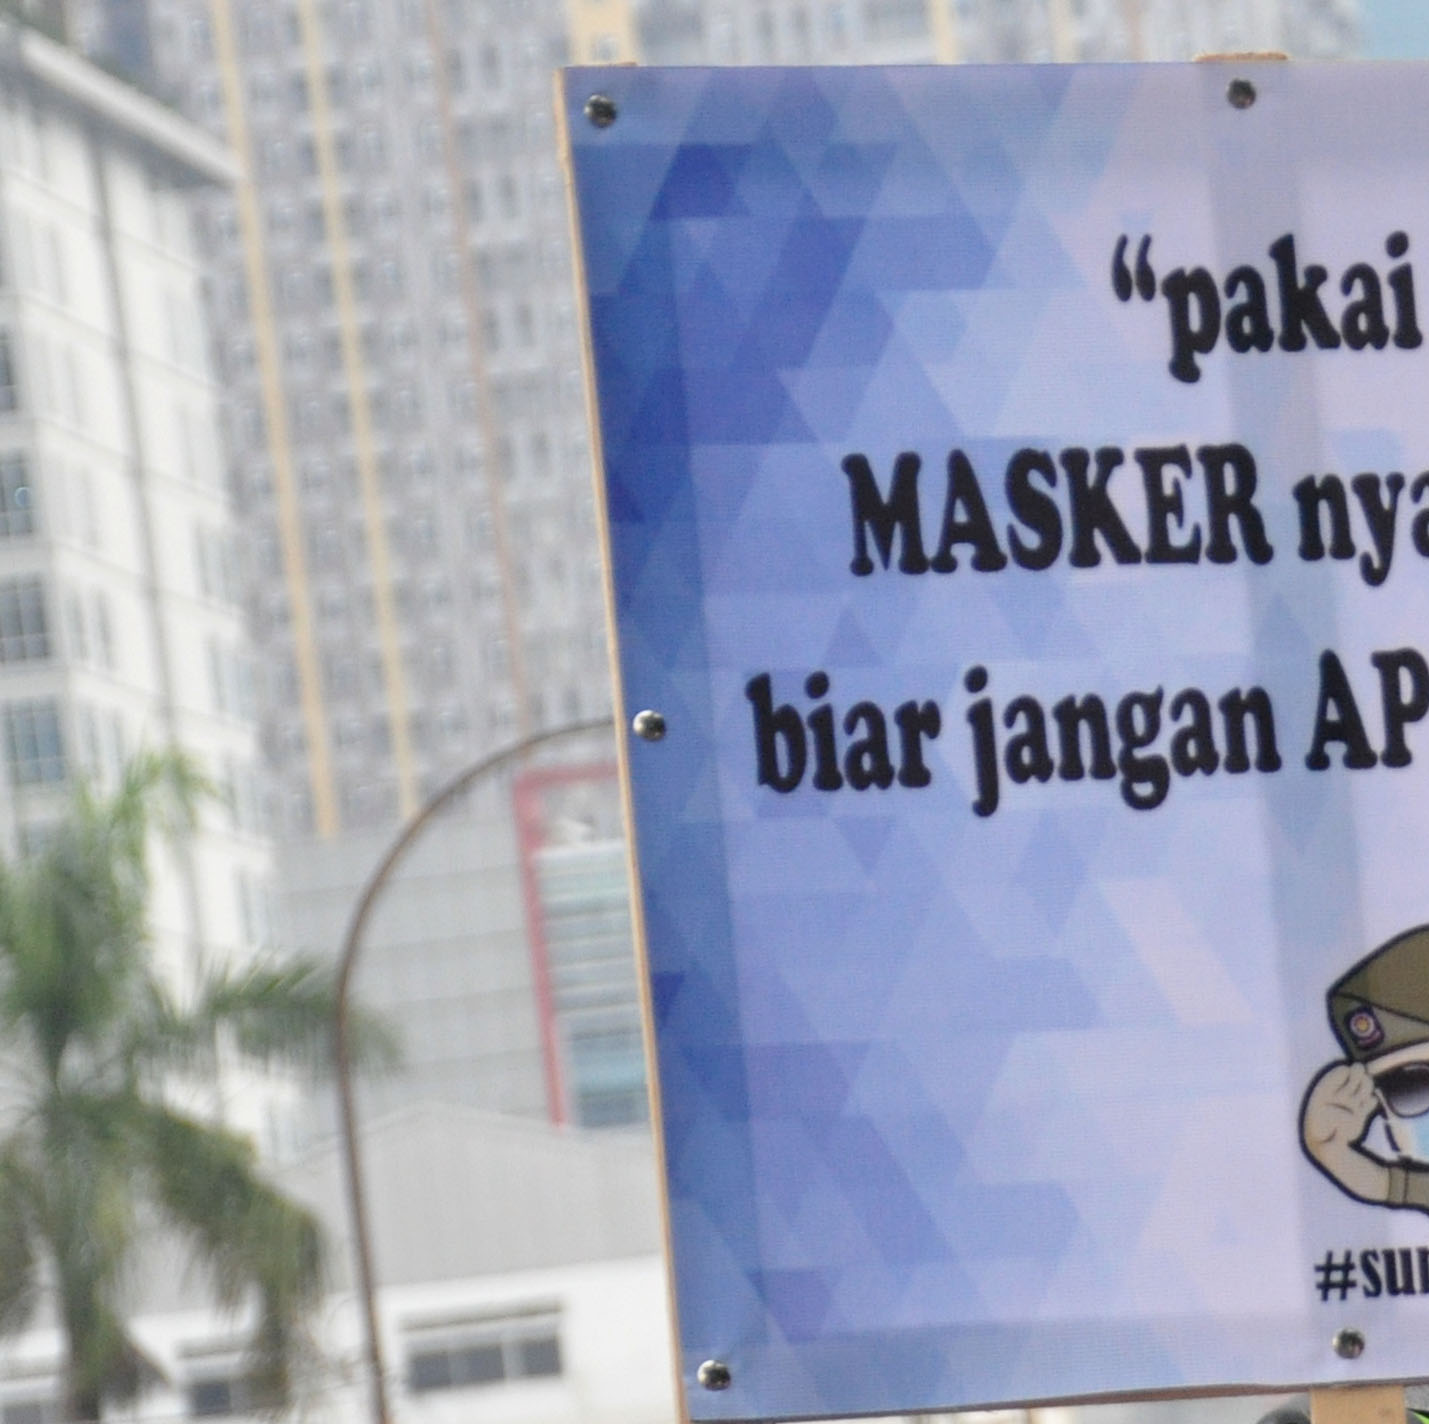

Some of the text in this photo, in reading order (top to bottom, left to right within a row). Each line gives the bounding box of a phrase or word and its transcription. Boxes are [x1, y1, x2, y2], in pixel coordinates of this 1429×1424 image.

[1112, 232, 1423, 383] “pakai
[842, 443, 1275, 576] MASKER
[747, 671, 942, 794] biar
[965, 666, 1282, 818] jangan
